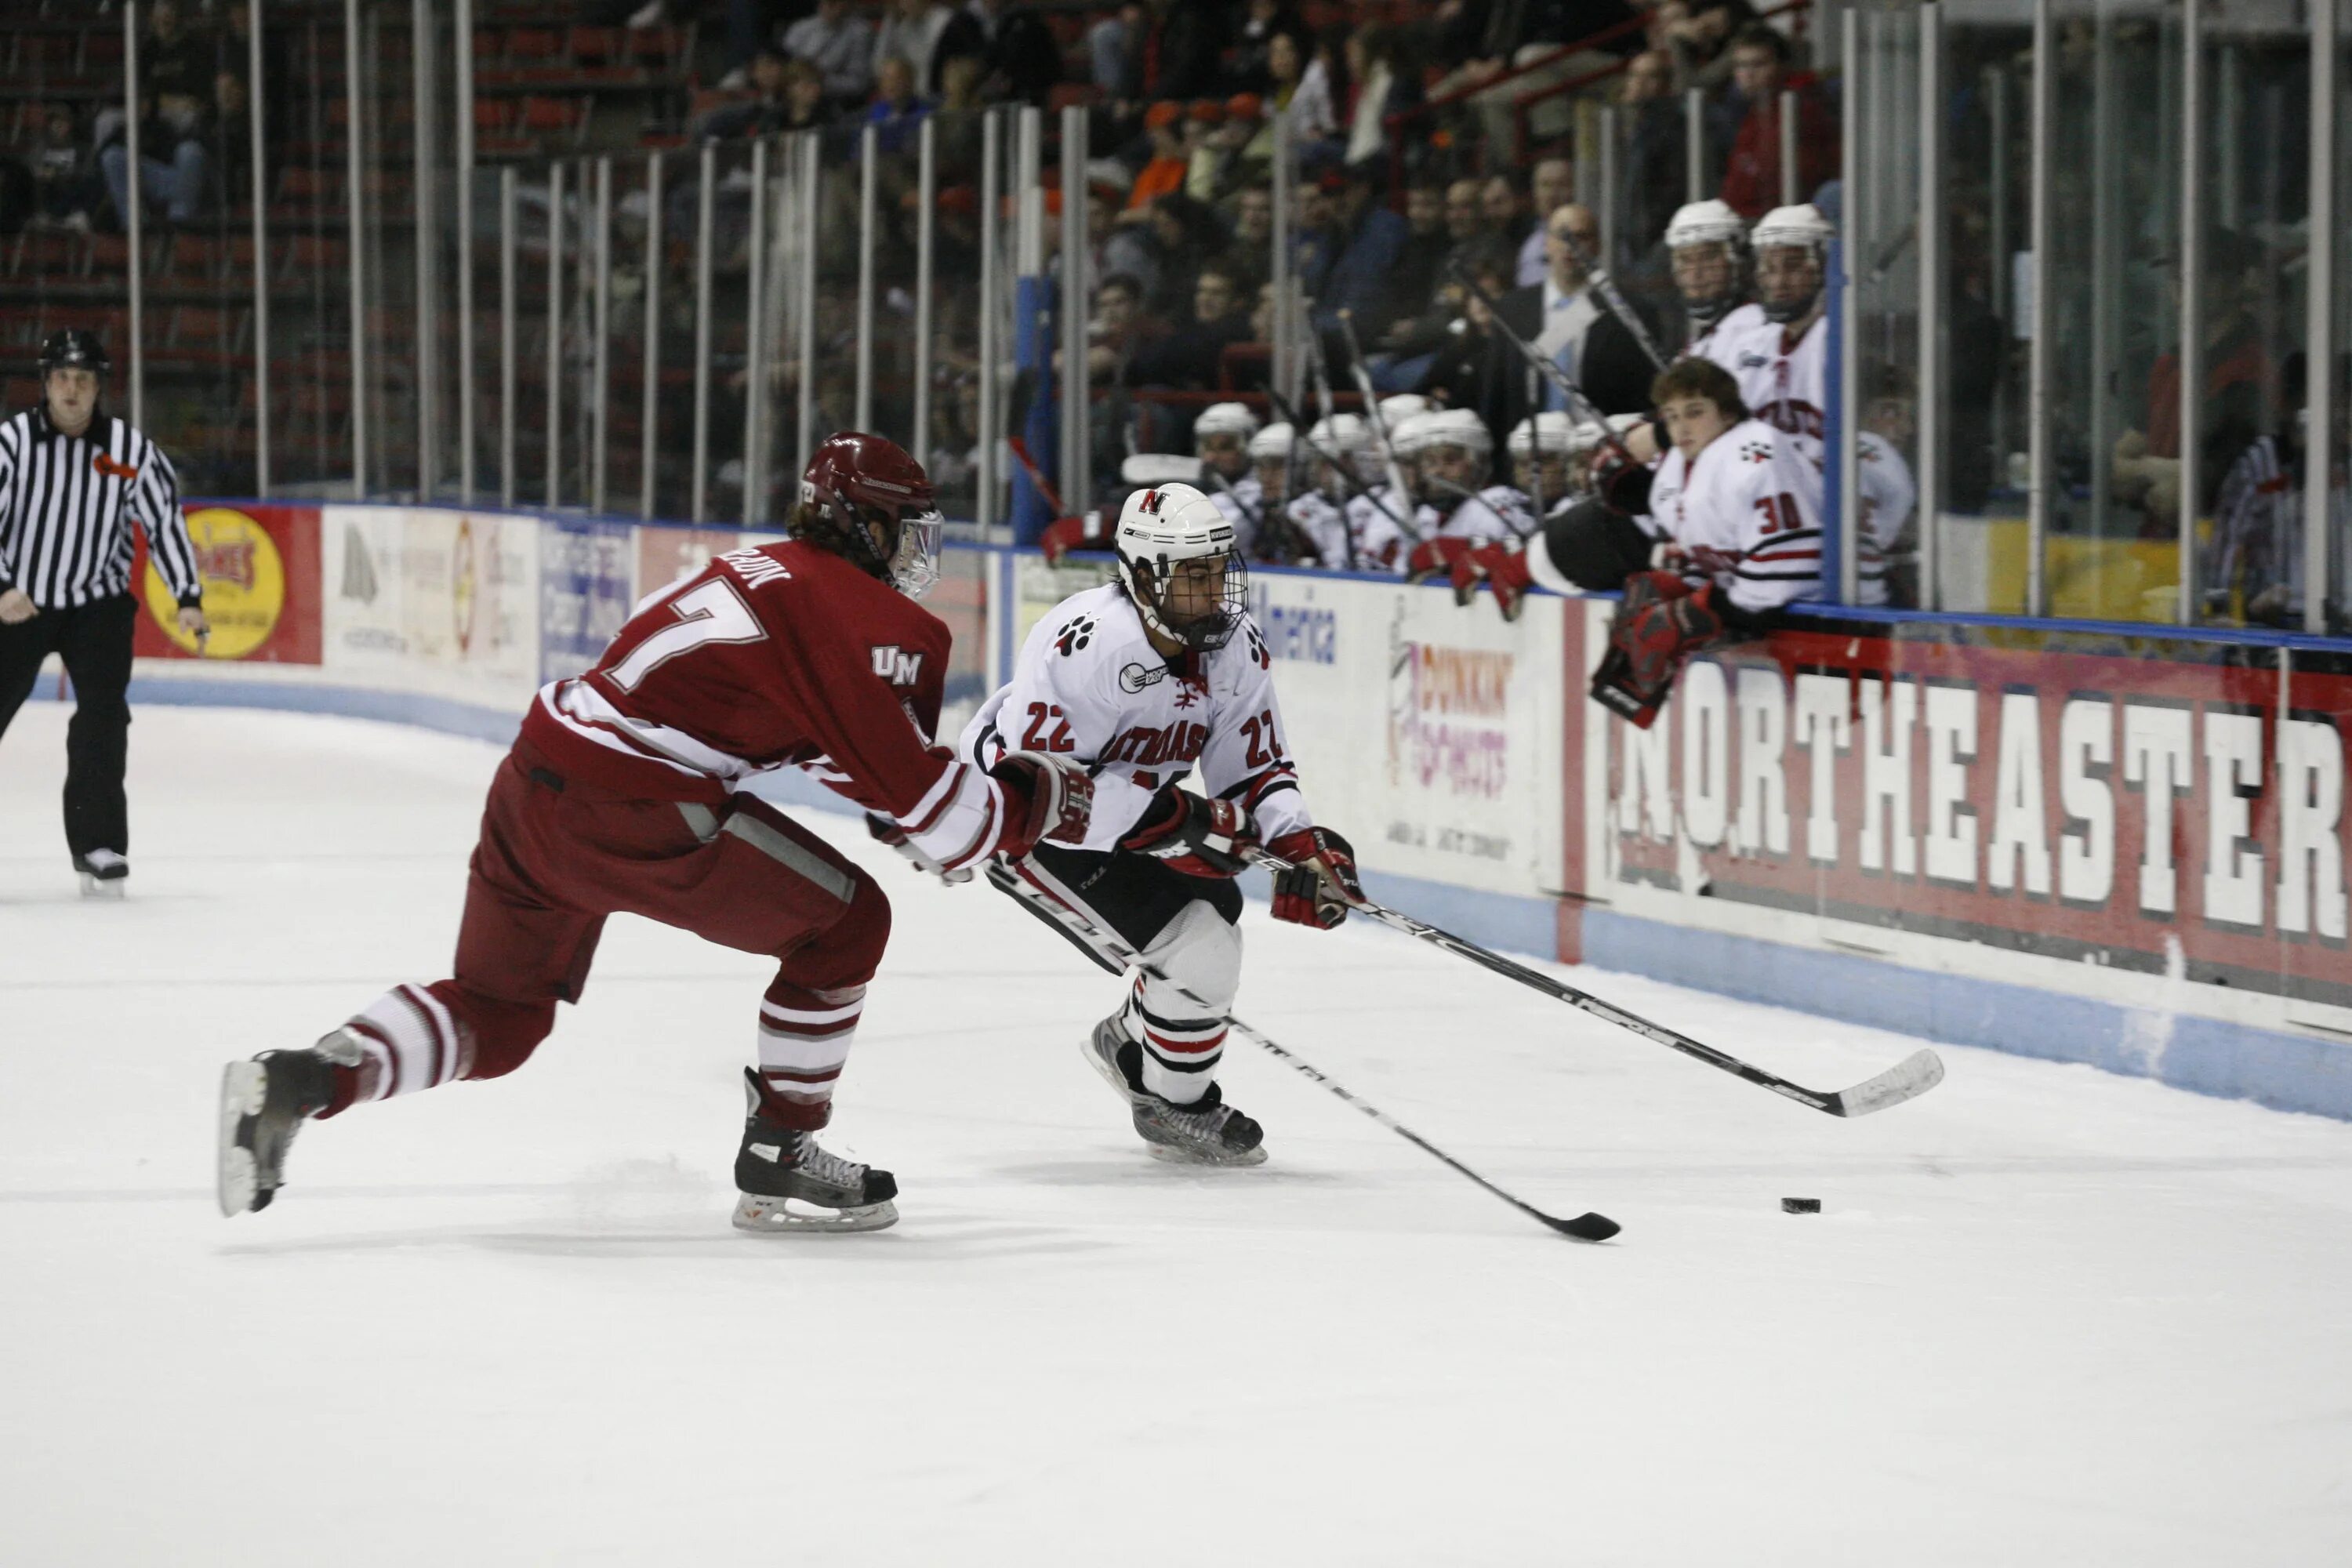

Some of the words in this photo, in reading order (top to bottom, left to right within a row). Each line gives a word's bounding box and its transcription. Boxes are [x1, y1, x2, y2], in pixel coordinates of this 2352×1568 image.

[1139, 489, 1171, 515] N
[717, 548, 792, 590] RAUN
[872, 646, 923, 685] UM
[1022, 701, 1075, 752] 22
